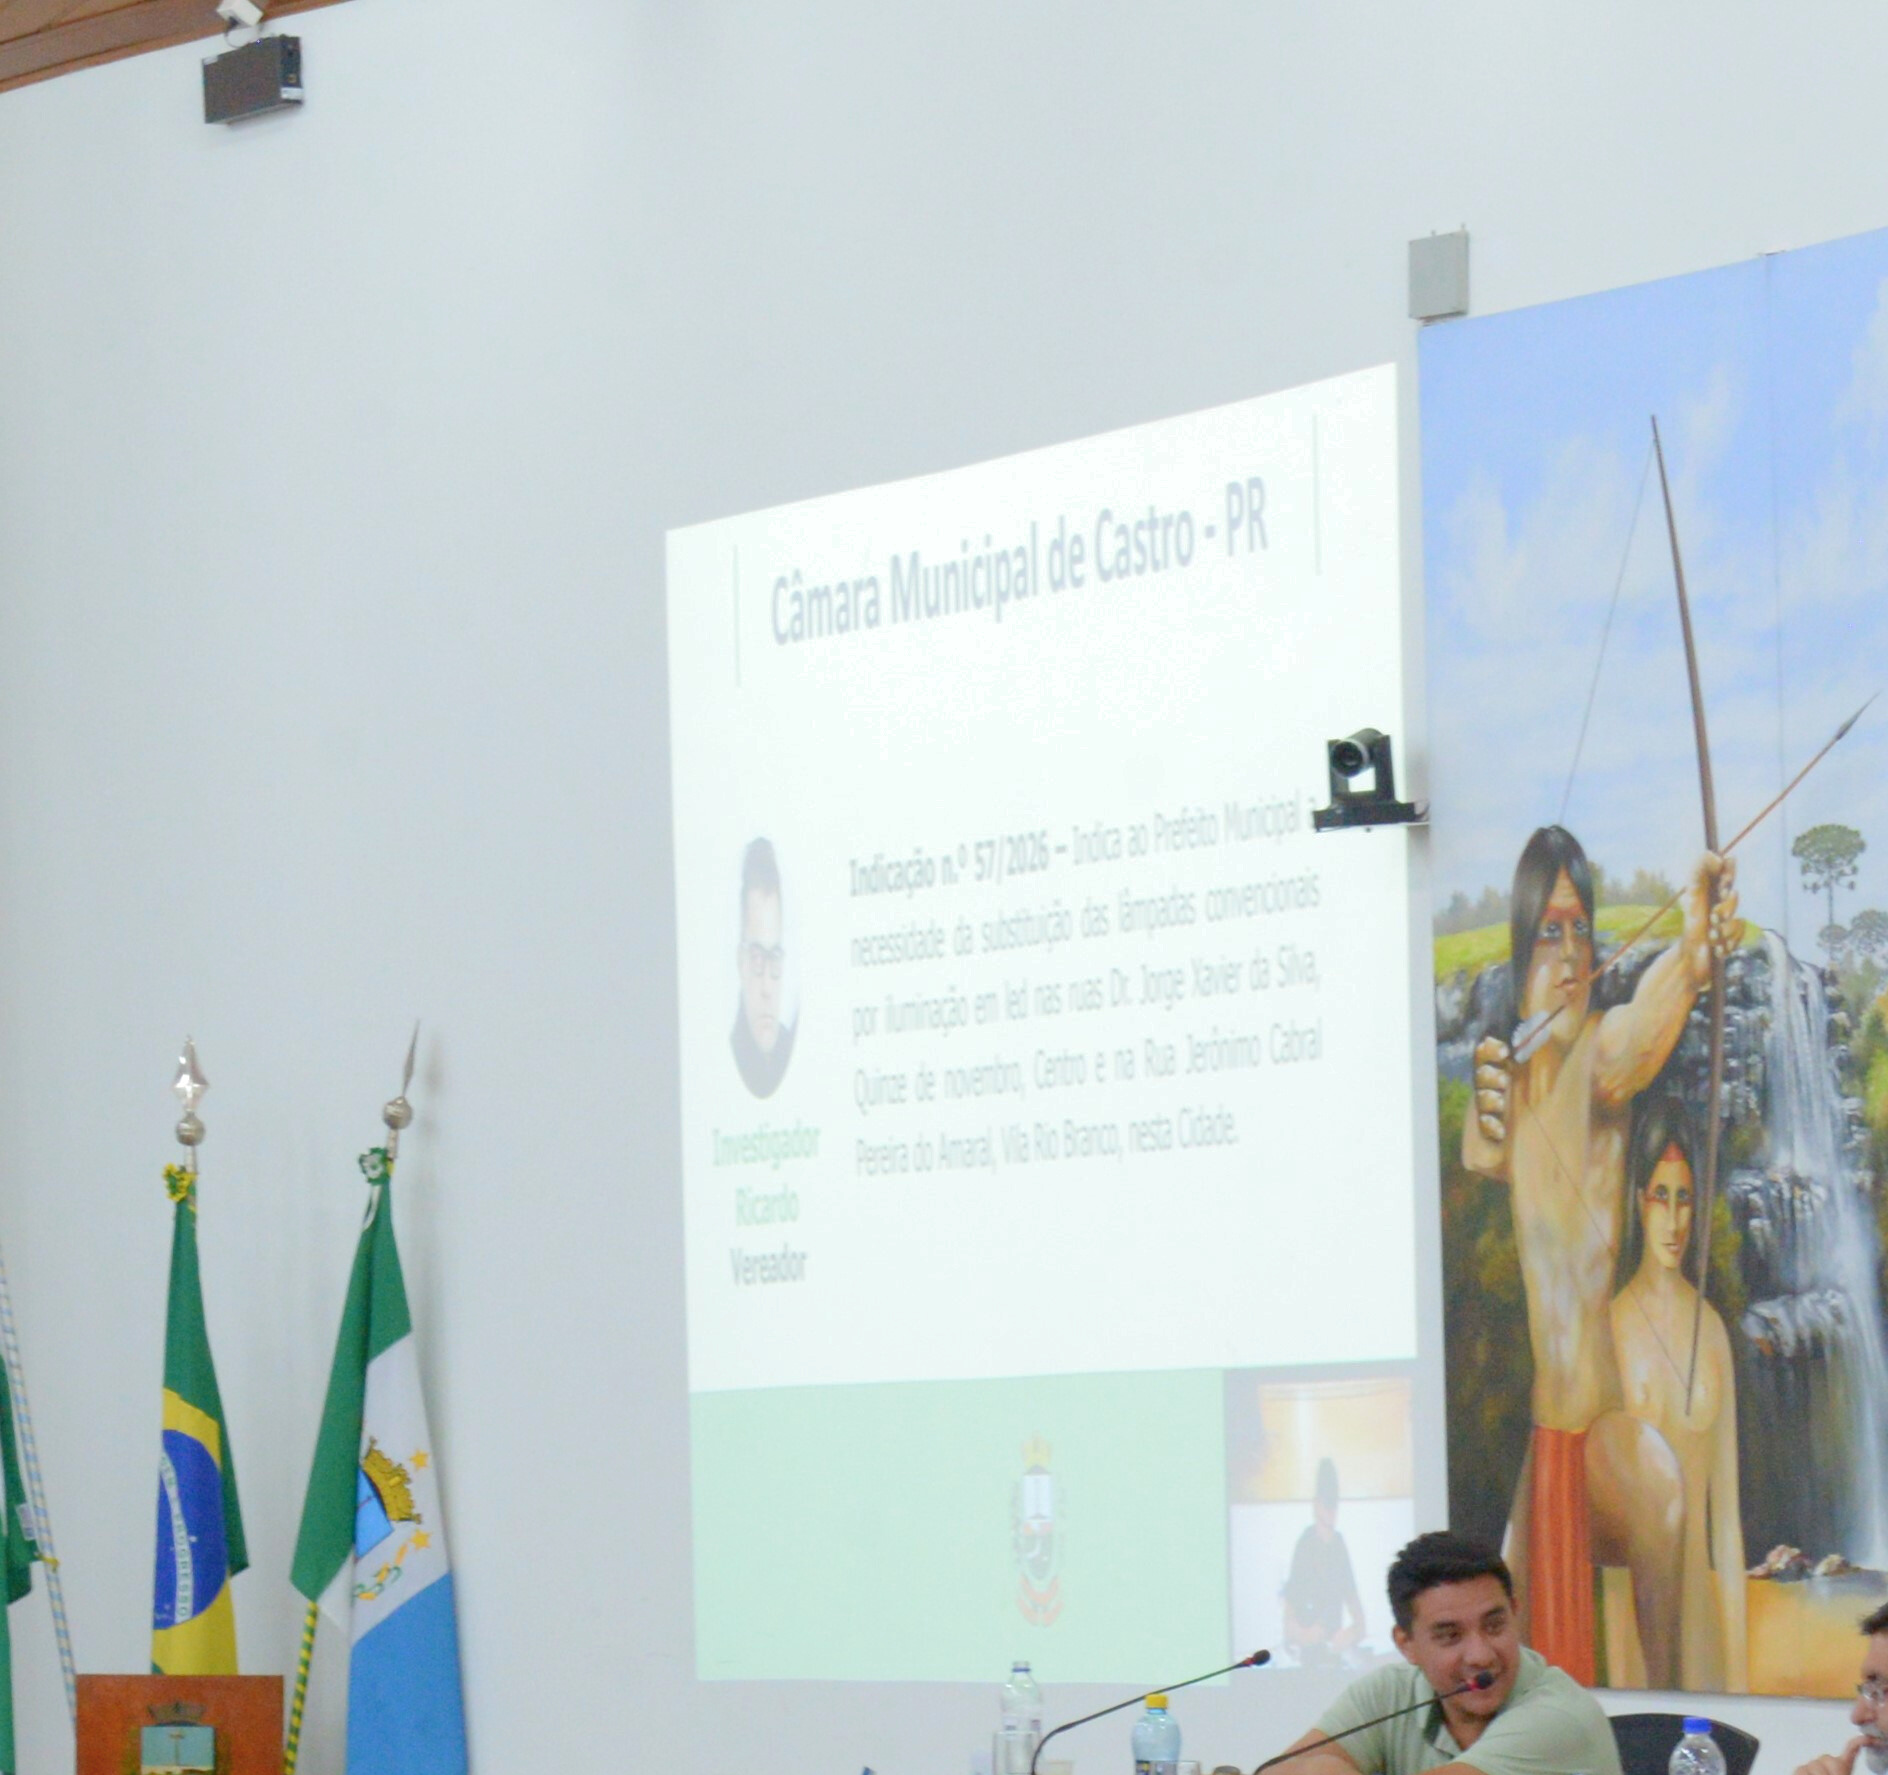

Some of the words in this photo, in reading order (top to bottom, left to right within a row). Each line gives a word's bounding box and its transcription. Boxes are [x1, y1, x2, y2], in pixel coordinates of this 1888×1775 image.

[771, 568, 881, 646] Câmara
[889, 520, 1040, 623] Municipal
[1047, 514, 1087, 593] de
[1094, 504, 1195, 582] Castro
[1224, 475, 1270, 556] PR
[849, 845, 936, 899] Indicação
[973, 828, 1050, 886] 57/2026
[1072, 820, 1122, 866] Indica
[1127, 823, 1149, 857] ao
[1153, 805, 1218, 852] Prefeito
[1224, 788, 1301, 845] Municipal
[850, 917, 944, 967] necessidade
[953, 914, 973, 956] da
[981, 897, 1073, 953] substituição
[1081, 896, 1110, 939] das
[1118, 884, 1196, 940] lâmpadas
[1206, 865, 1321, 923] convencionais
[852, 1006, 879, 1045] por
[885, 983, 967, 1038] iluminação
[975, 991, 998, 1026] em
[1004, 977, 1029, 1021] led
[1034, 982, 1063, 1016] nas
[1069, 976, 1104, 1012] ruas
[1110, 966, 1133, 1008] Dr.
[1139, 962, 1185, 1012] Jorge
[1190, 953, 1244, 998] Xavier
[1249, 947, 1270, 992] da
[1277, 942, 1322, 992] Silva,
[853, 1067, 907, 1117] Quinze
[914, 1060, 936, 1103] de
[944, 1054, 1027, 1102] novembro,
[1034, 1048, 1087, 1090] Centro
[1094, 1051, 1107, 1084] e
[1114, 1047, 1135, 1081] na
[1145, 1036, 1177, 1078] Rua
[1185, 1025, 1262, 1075] Jerônimo
[1269, 1015, 1323, 1065] Cabral
[712, 1118, 821, 1169] Investigador
[855, 1135, 909, 1177] Pereira
[913, 1131, 934, 1173] do
[937, 1125, 997, 1175] Amaral,
[1000, 1121, 1030, 1164] Vila
[1033, 1119, 1060, 1162] Rio
[1063, 1117, 1124, 1163] Branco,
[1128, 1112, 1173, 1154] nesta
[1178, 1102, 1240, 1149] Cidade.
[735, 1182, 800, 1227] Ricardo
[729, 1241, 808, 1286] Vereador
